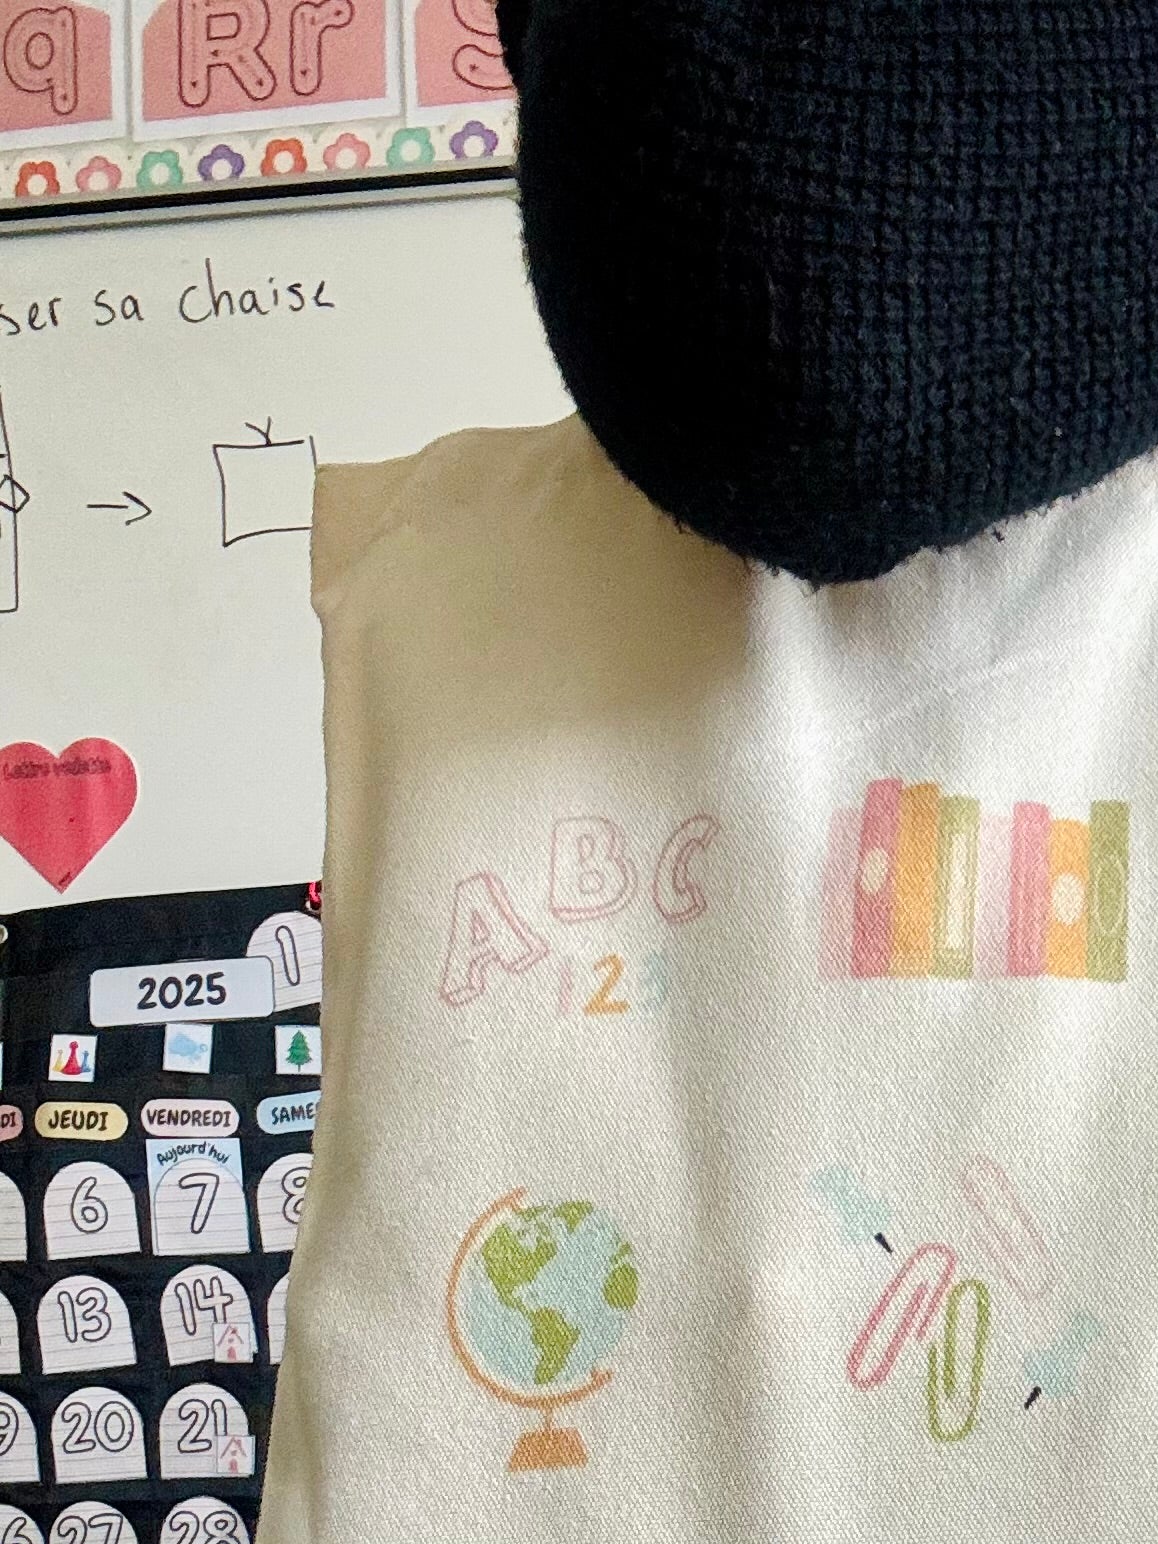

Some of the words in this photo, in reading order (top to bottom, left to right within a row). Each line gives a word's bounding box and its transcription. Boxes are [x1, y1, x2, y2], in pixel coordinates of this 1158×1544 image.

[178, 0, 355, 108] Rr
[93, 288, 145, 326] sa
[136, 972, 228, 1010] 2025
[48, 1109, 109, 1131] JEUDI
[146, 1108, 231, 1128] VENDREDI
[271, 1101, 320, 1126] SAME
[156, 1141, 230, 1166] Aujourd'hui
[70, 1176, 108, 1234] 6
[178, 1172, 221, 1234] 7
[57, 1286, 112, 1343] 13
[174, 1276, 234, 1336] 14
[61, 1400, 135, 1454] 20
[177, 1398, 228, 1454] 21
